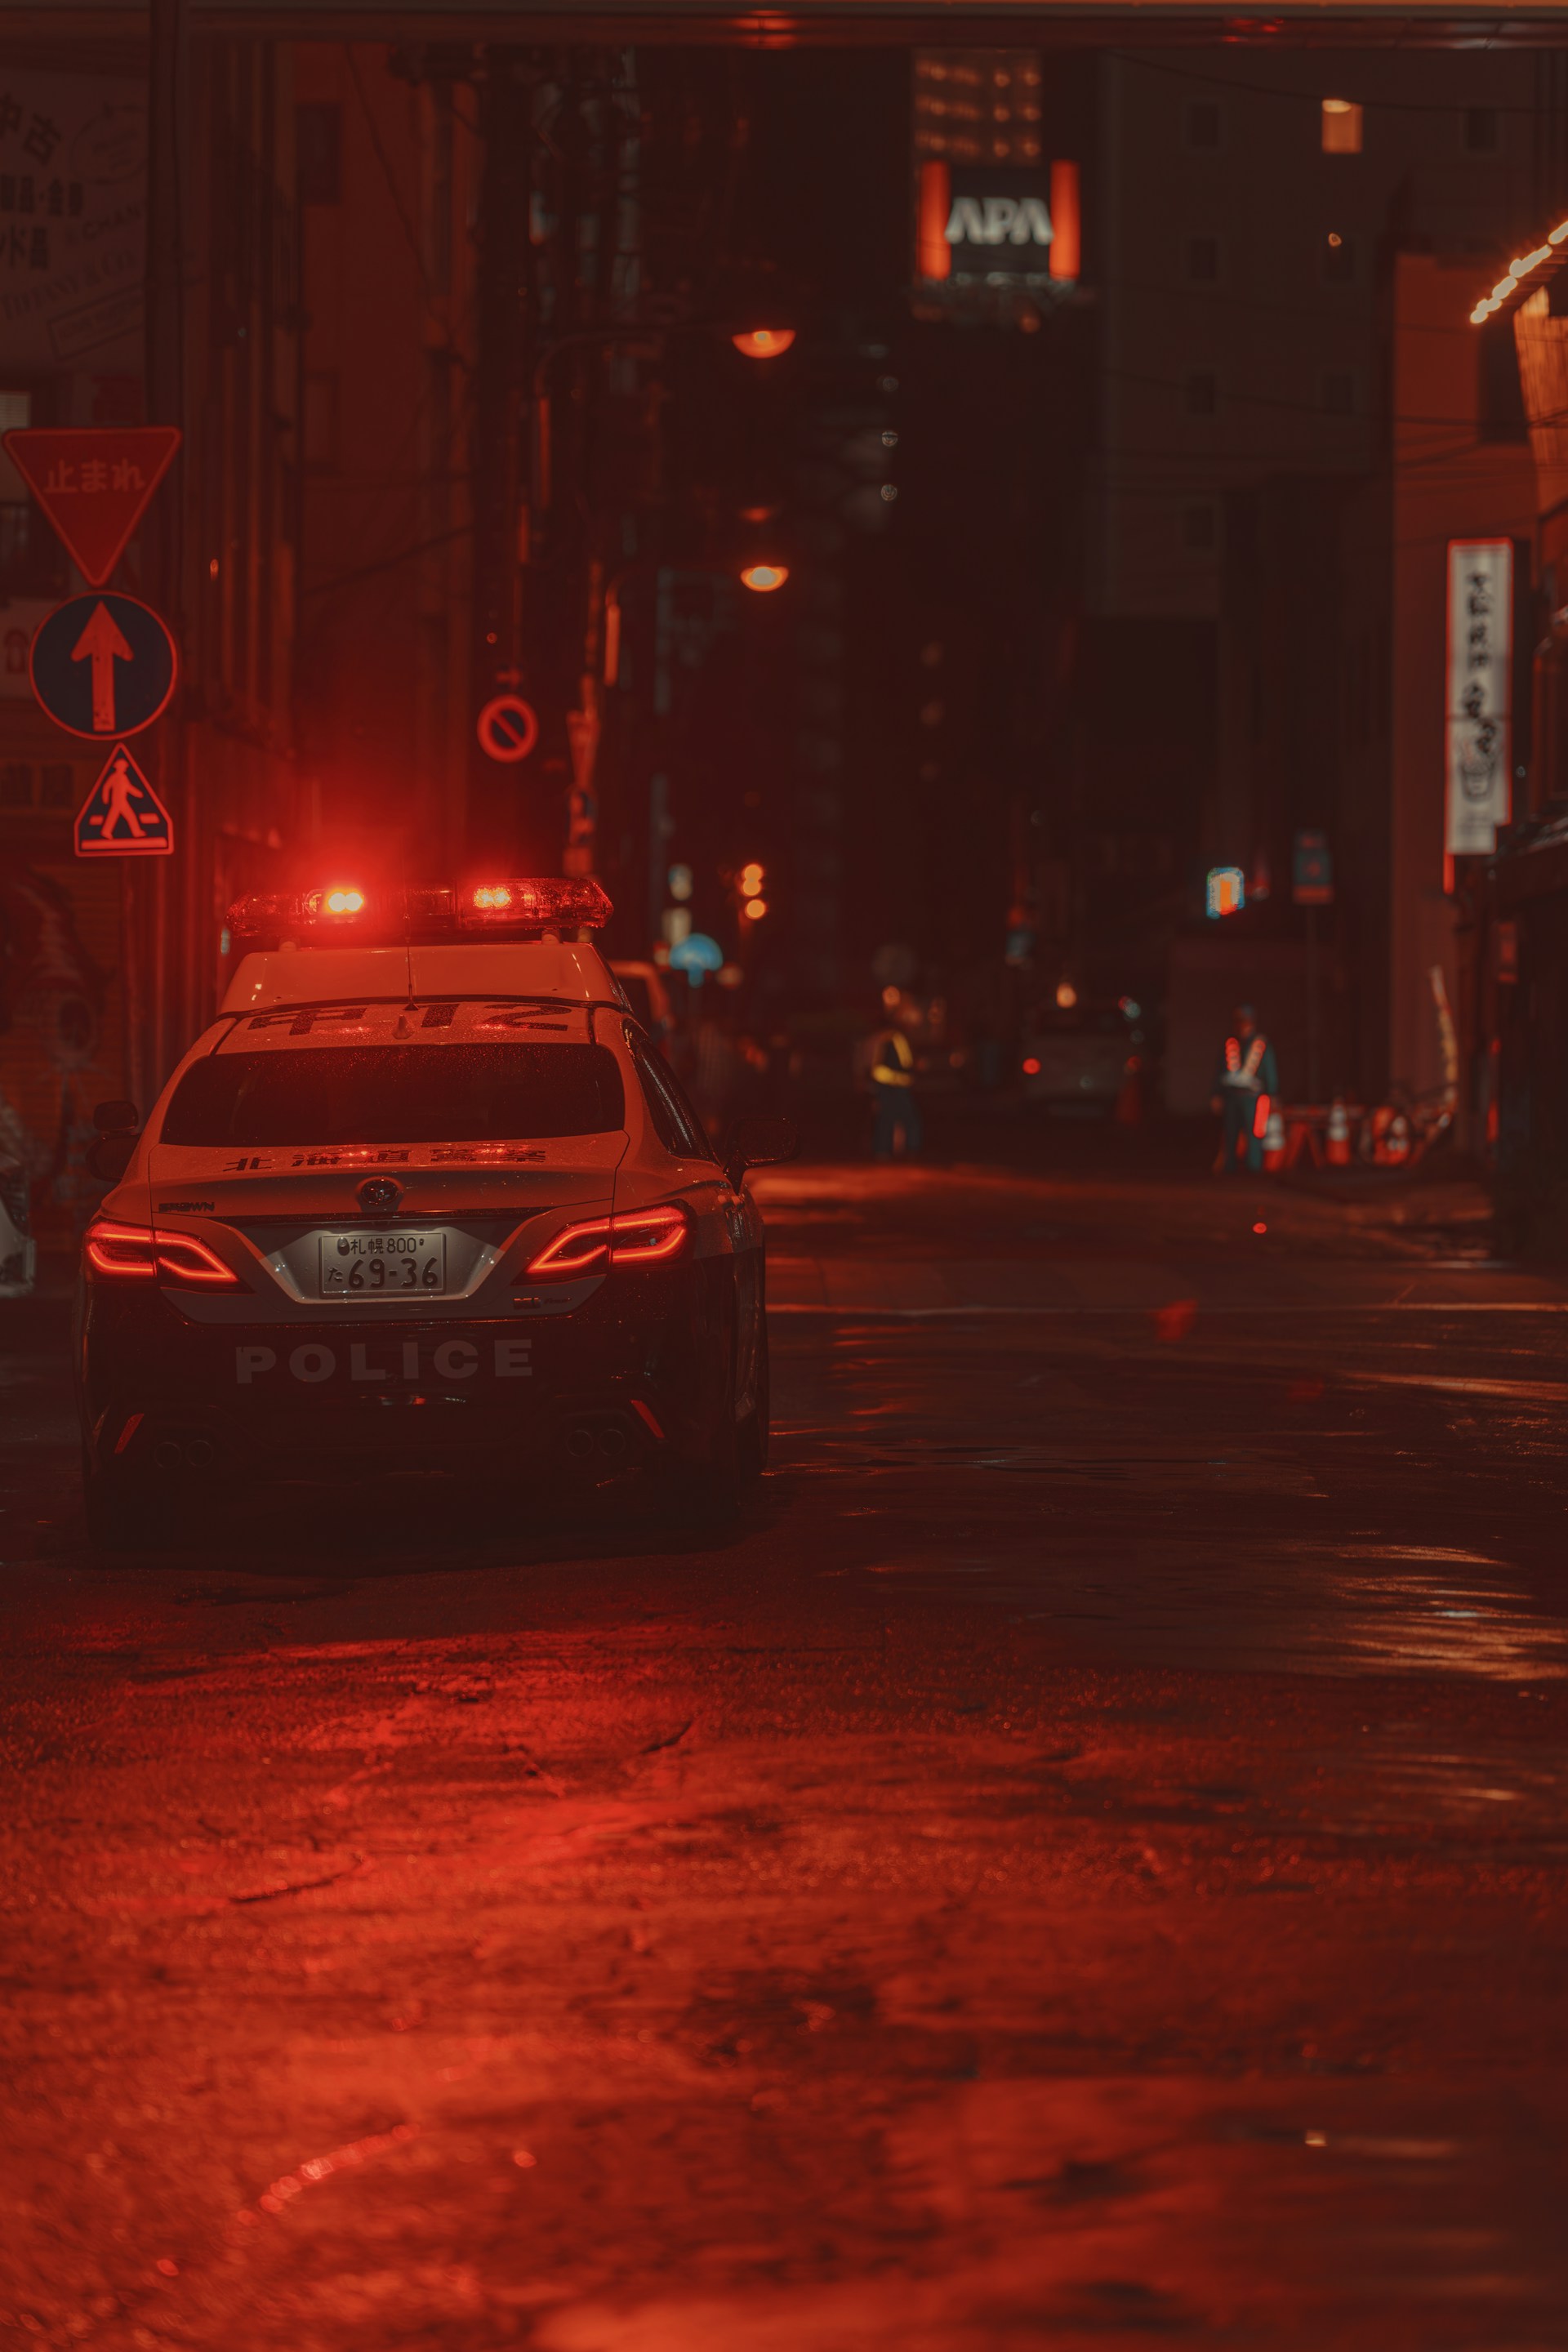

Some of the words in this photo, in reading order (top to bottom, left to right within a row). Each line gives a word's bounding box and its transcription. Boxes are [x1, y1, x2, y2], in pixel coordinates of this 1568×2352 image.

[944, 196, 1054, 245] APA
[42, 457, 145, 492] 止まれ
[223, 1149, 546, 1172] 北海道警察
[349, 1257, 438, 1289] 69-36
[235, 1339, 532, 1383] POLICE
